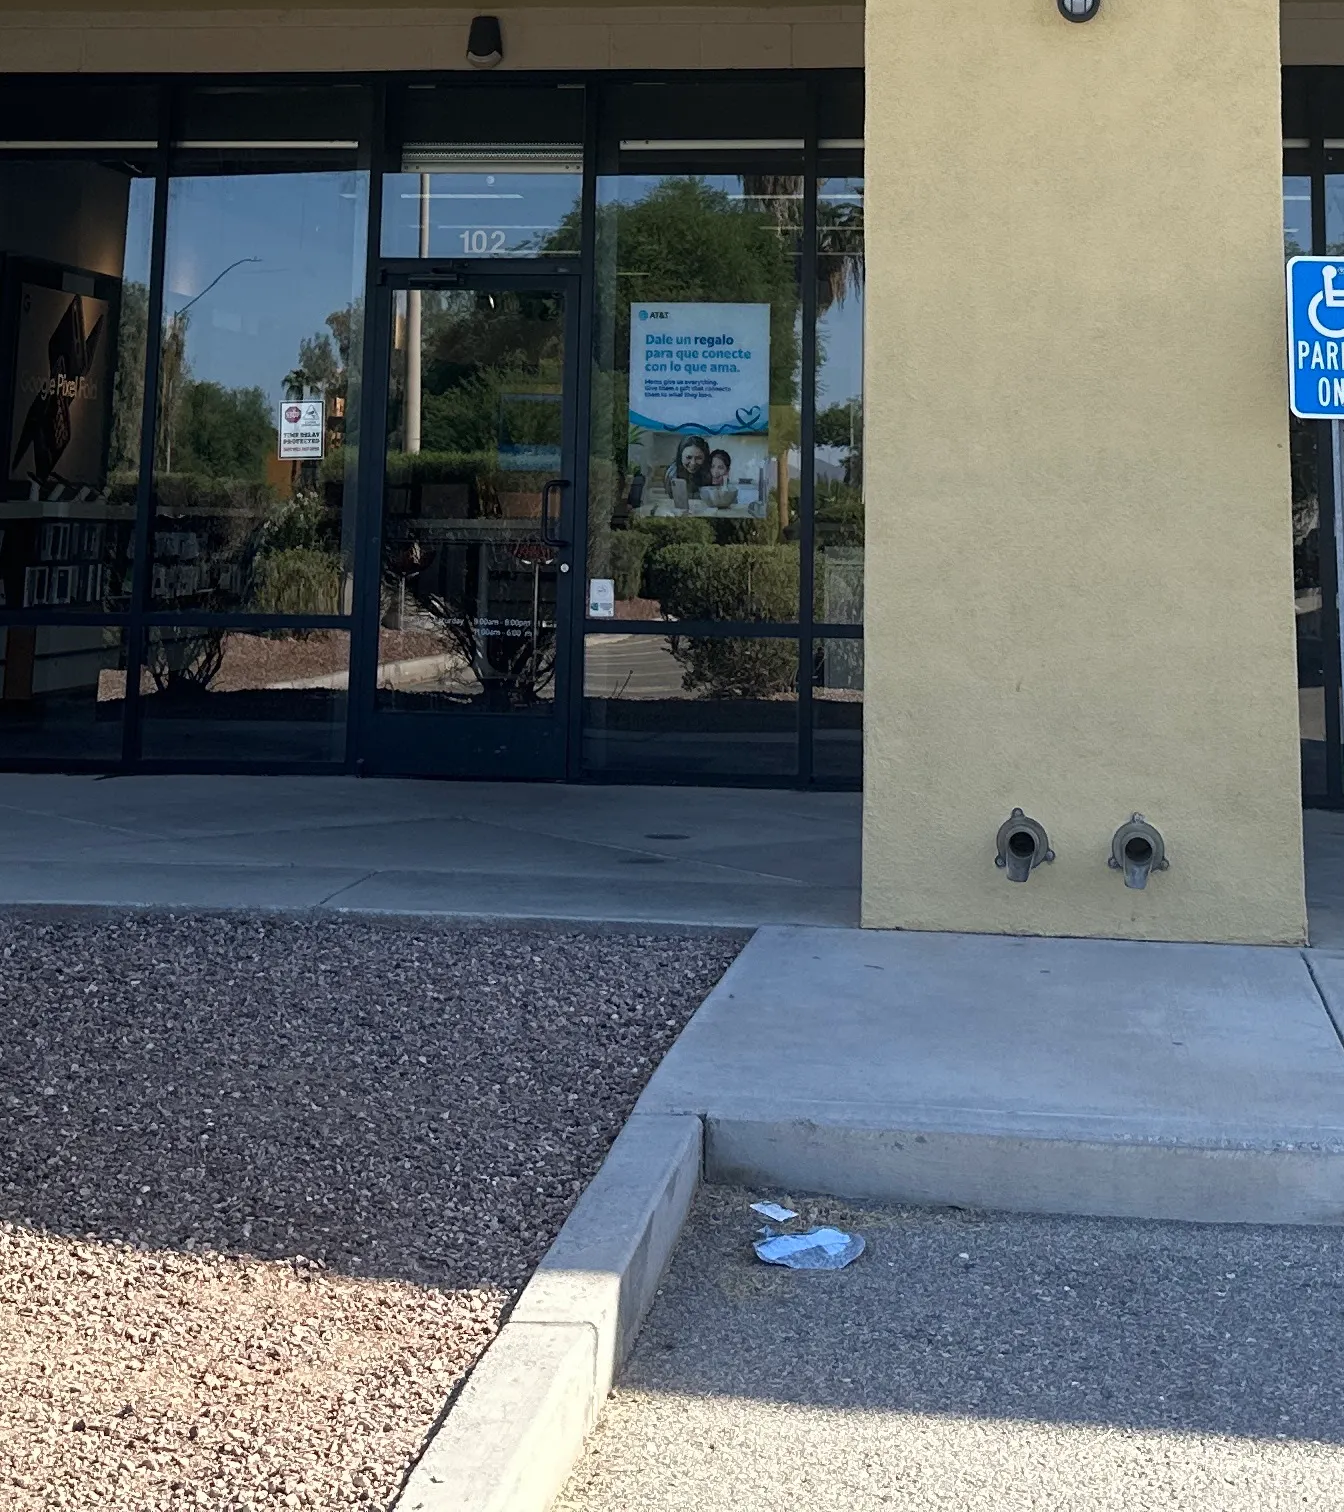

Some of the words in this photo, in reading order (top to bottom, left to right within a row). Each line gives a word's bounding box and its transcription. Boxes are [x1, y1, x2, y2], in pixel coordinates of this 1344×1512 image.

[459, 230, 506, 254] 102
[649, 311, 669, 319] AT&T
[645, 334, 673, 345] Dale
[676, 336, 691, 345] un
[694, 334, 734, 348] regalo
[645, 349, 673, 360] para
[676, 349, 699, 360] que
[701, 348, 751, 360] conecte
[644, 363, 667, 372] con
[670, 361, 681, 372] lo
[684, 363, 707, 374] que
[710, 363, 740, 373] ama.
